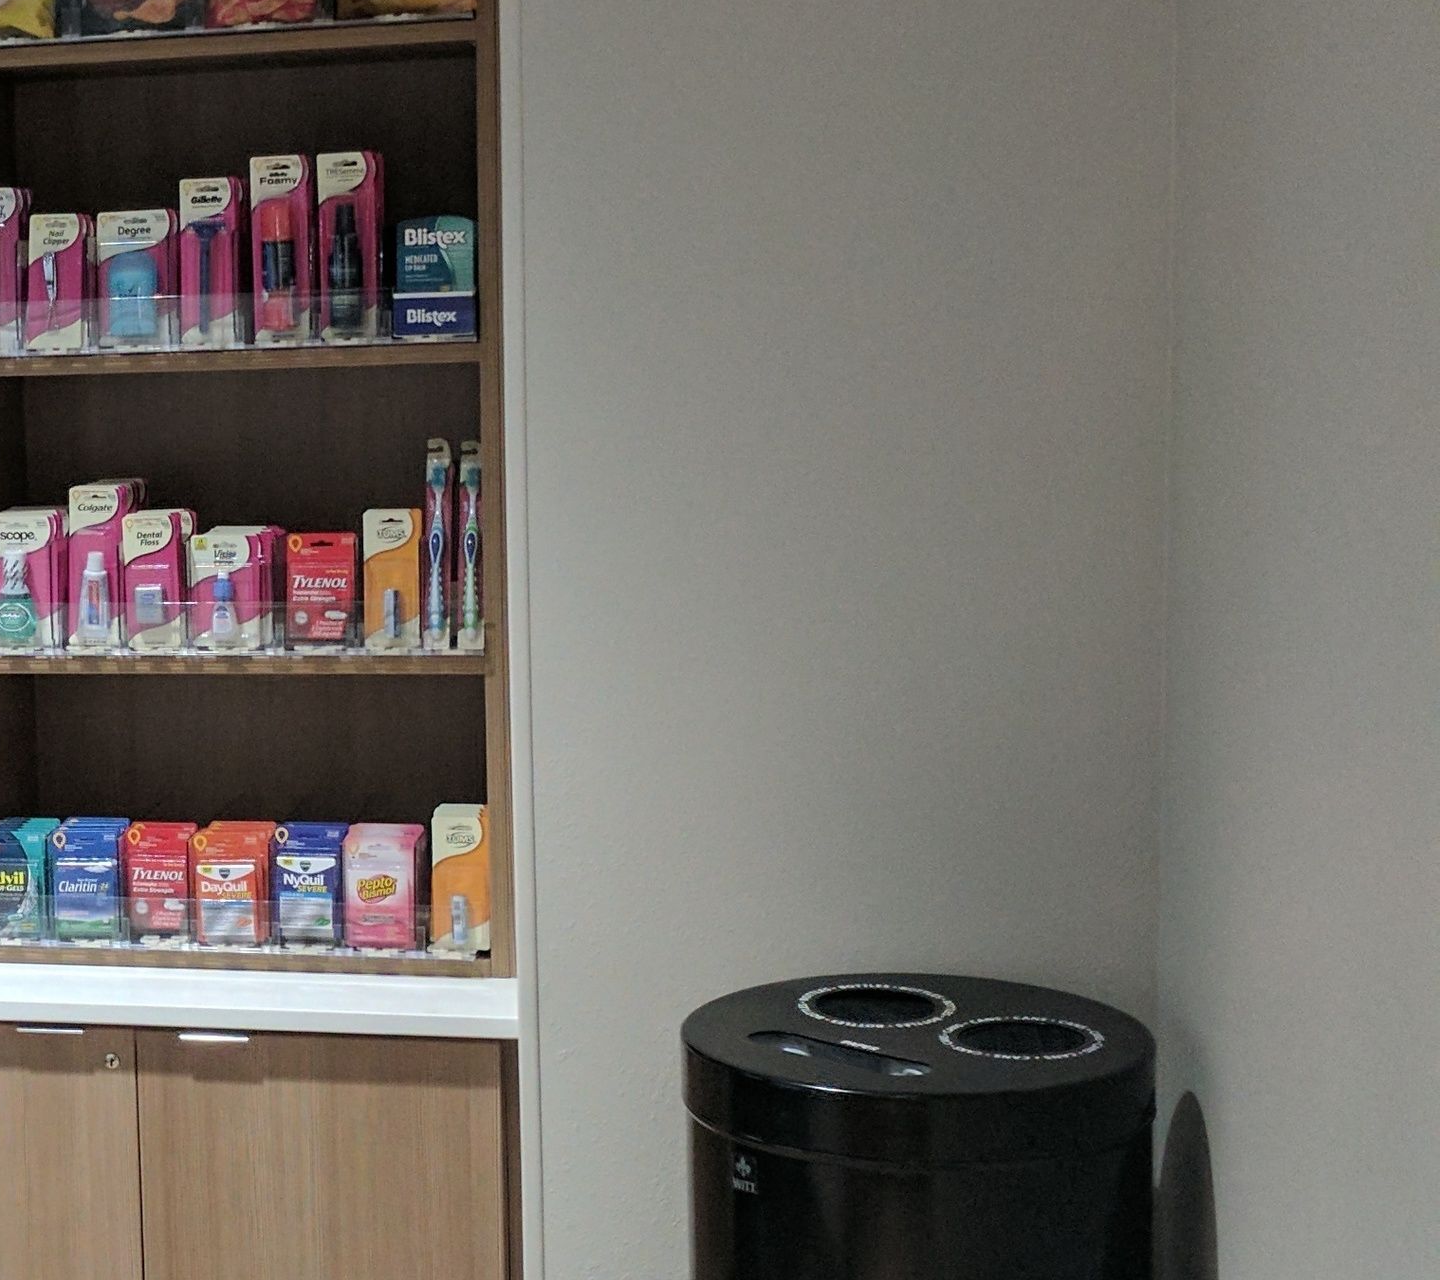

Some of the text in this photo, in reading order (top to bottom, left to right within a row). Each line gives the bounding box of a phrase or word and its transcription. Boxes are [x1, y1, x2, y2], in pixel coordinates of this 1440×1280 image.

[117, 226, 151, 237] Degree
[403, 228, 466, 250] Blistex
[407, 309, 457, 327] Blistex
[78, 503, 113, 513] Colgate
[0, 530, 35, 543] scope
[292, 574, 348, 590] TYLENOL
[132, 867, 185, 881] TYLENOL
[283, 873, 324, 889] NyQuil
[58, 880, 97, 893] Claritin
[201, 881, 247, 896] DayQuil
